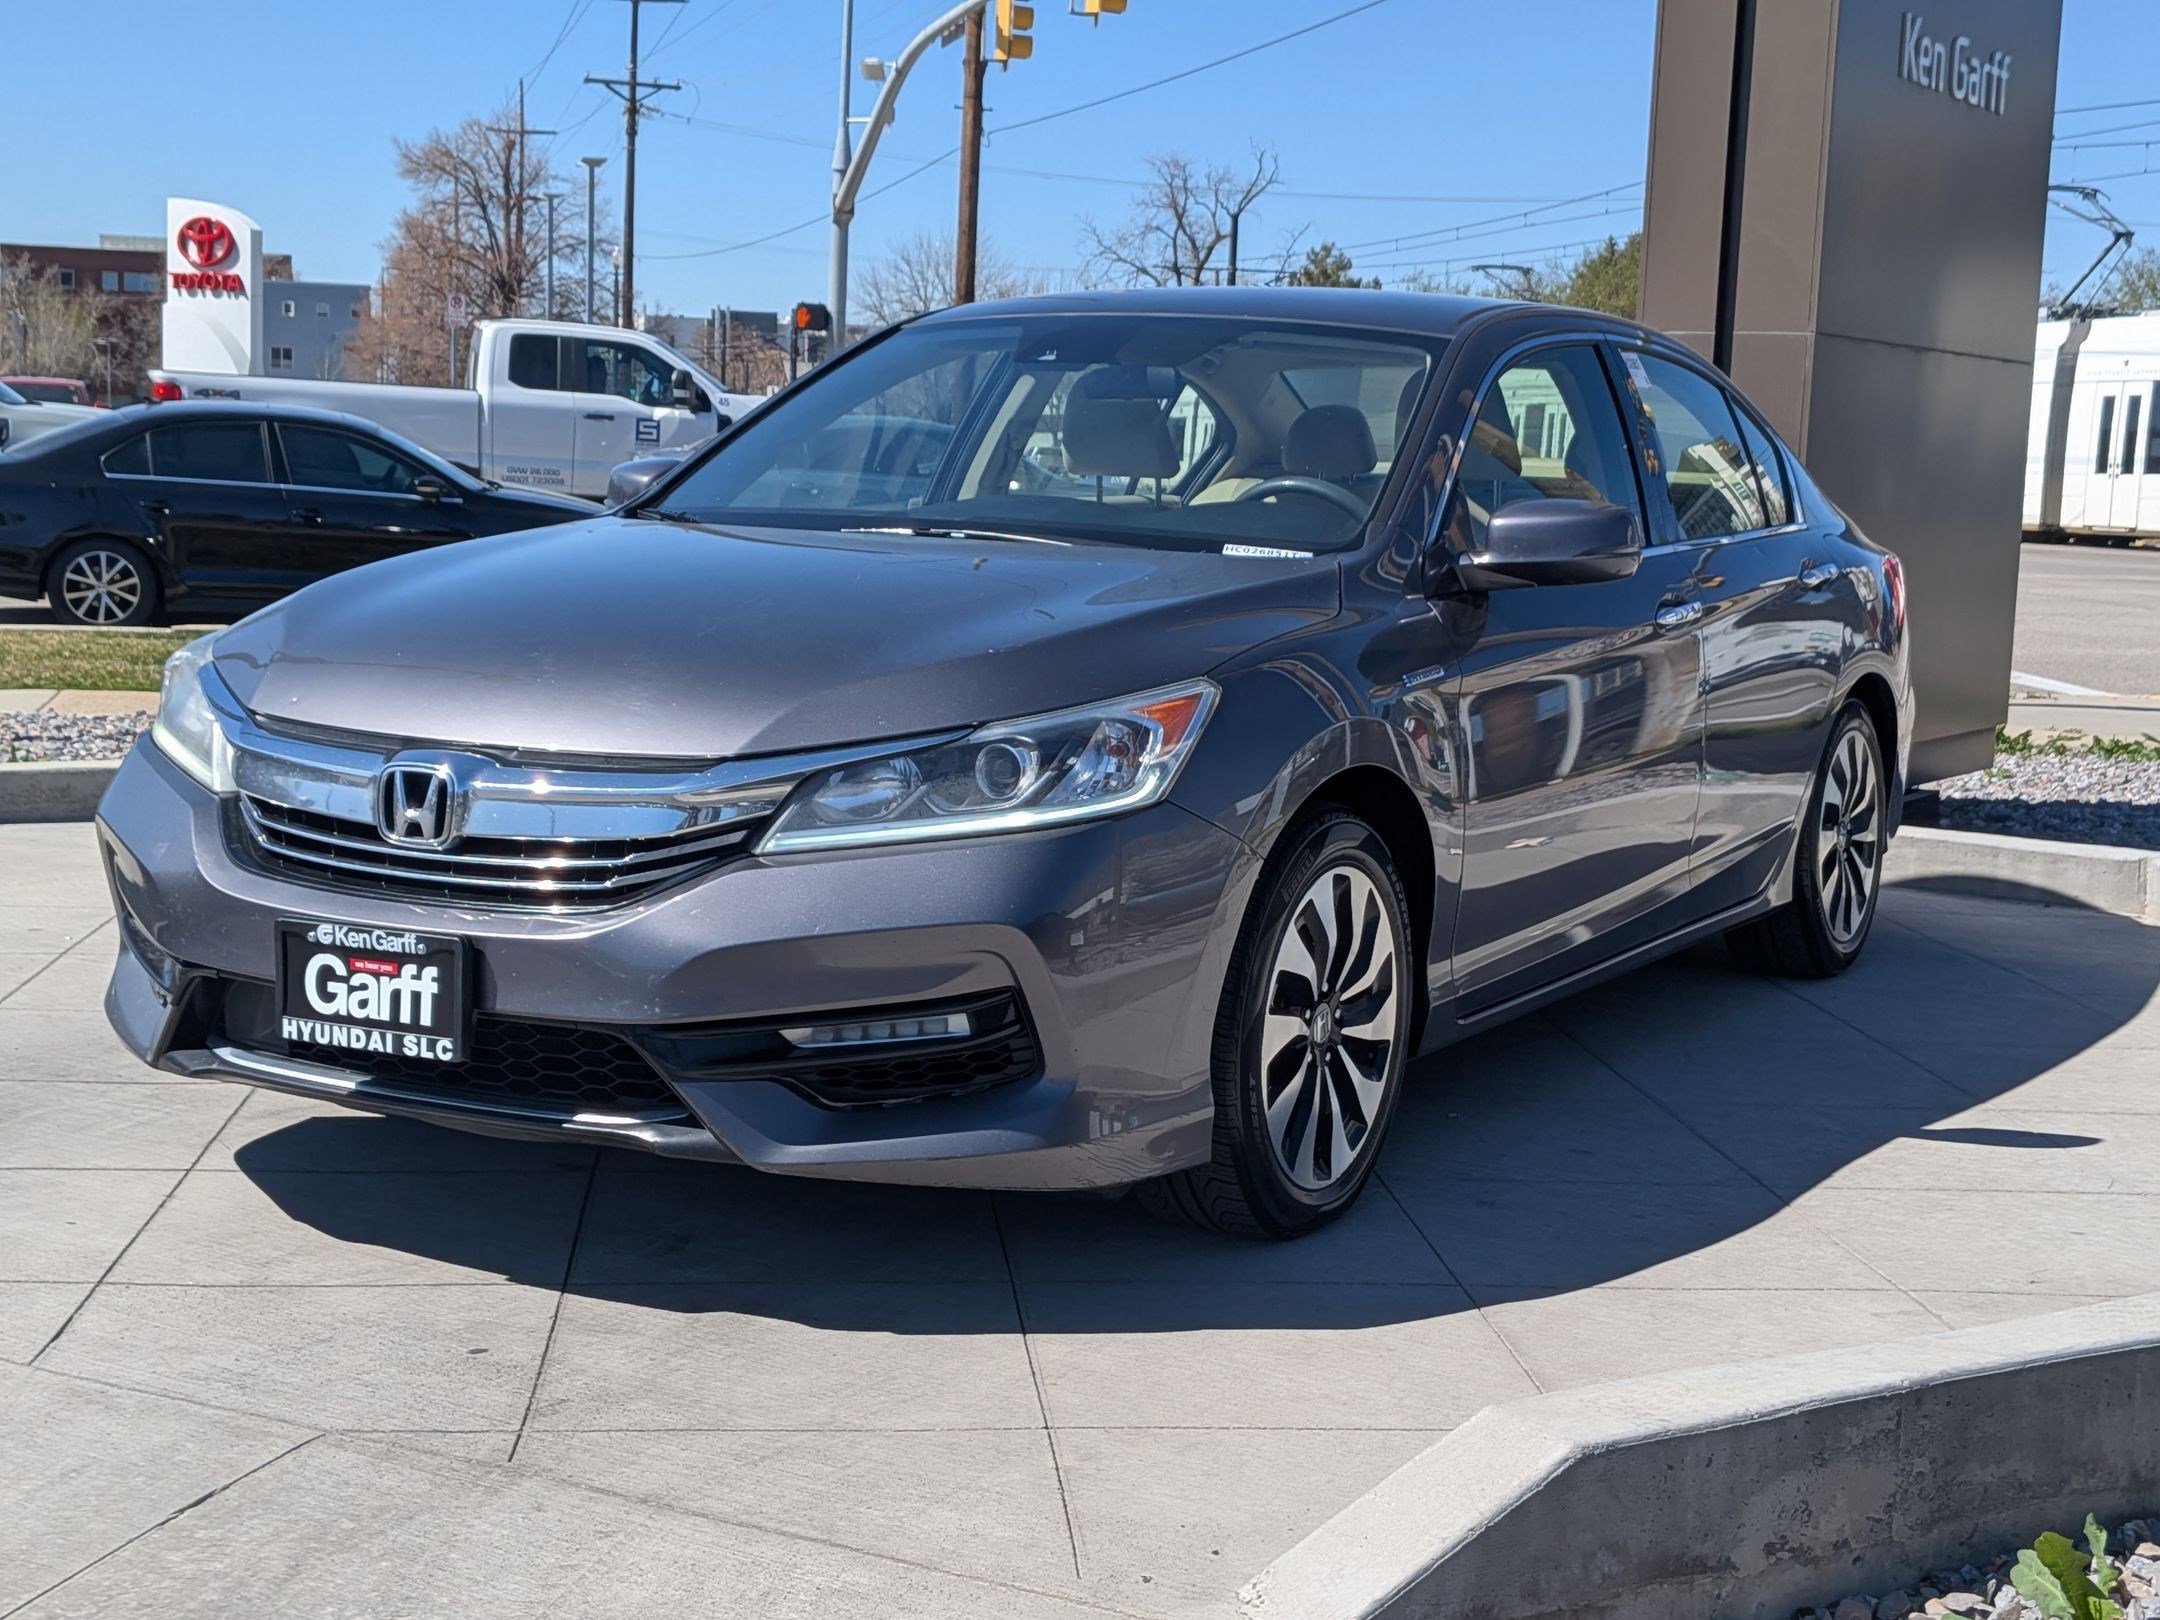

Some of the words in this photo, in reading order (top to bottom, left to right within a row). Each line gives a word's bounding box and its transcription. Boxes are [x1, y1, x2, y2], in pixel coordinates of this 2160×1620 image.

[1900, 12, 1946, 92] Ken
[1950, 36, 2011, 116] Garff
[169, 271, 244, 293] TOYOTA
[304, 953, 439, 1027] Garff
[282, 1018, 393, 1054] HYUNDAI
[402, 1035, 454, 1061] SLC
